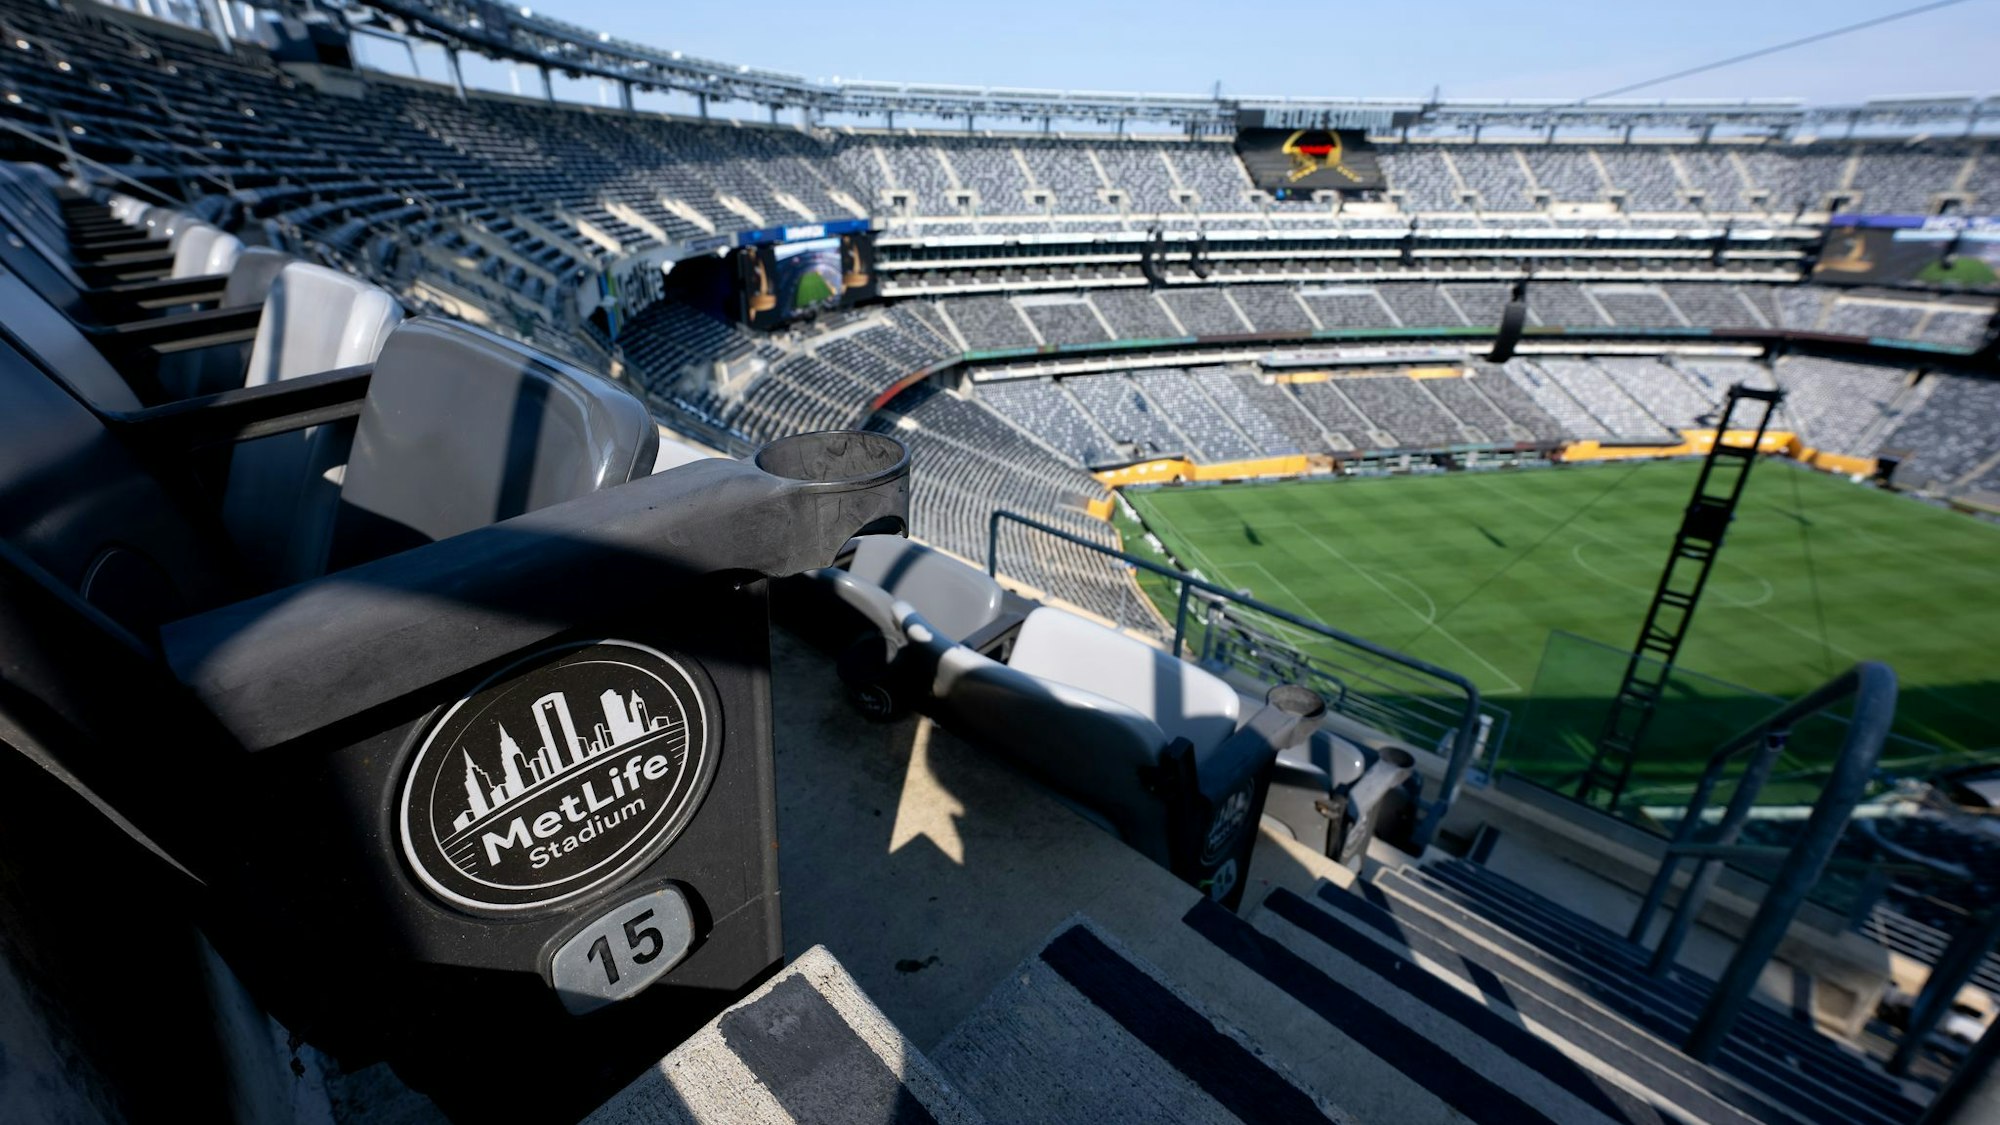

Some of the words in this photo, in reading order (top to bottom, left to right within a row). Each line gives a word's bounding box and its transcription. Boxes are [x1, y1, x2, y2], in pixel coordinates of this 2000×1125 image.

[481, 755, 669, 866] MetLife
[528, 798, 646, 869] Stadium
[586, 908, 664, 985] 15
